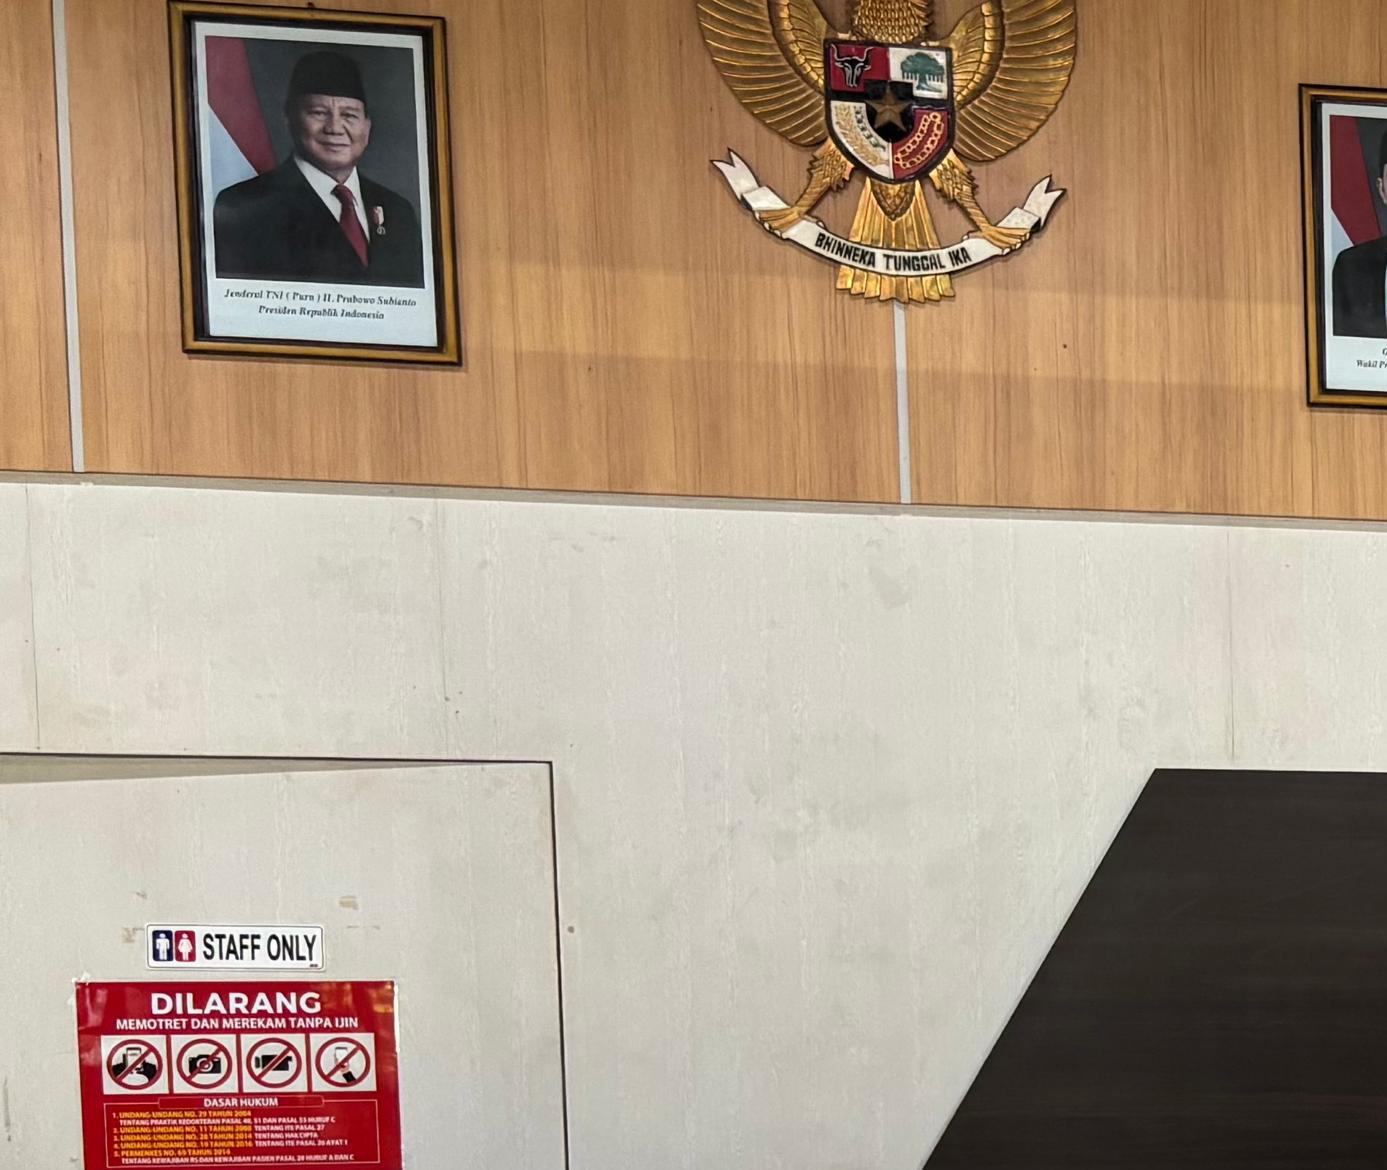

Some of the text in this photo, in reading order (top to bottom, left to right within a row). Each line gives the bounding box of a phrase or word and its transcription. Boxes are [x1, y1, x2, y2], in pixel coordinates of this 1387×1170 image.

[814, 232, 876, 268] BHINNEKA
[949, 247, 971, 267] IKA
[202, 933, 317, 961] STAFF ONLY
[151, 992, 321, 1015] DILARANG
[116, 1017, 358, 1030] MEMOTRET DAN MEREKAM TANPA IJIN
[204, 1097, 278, 1107] DASAR HUKUM
